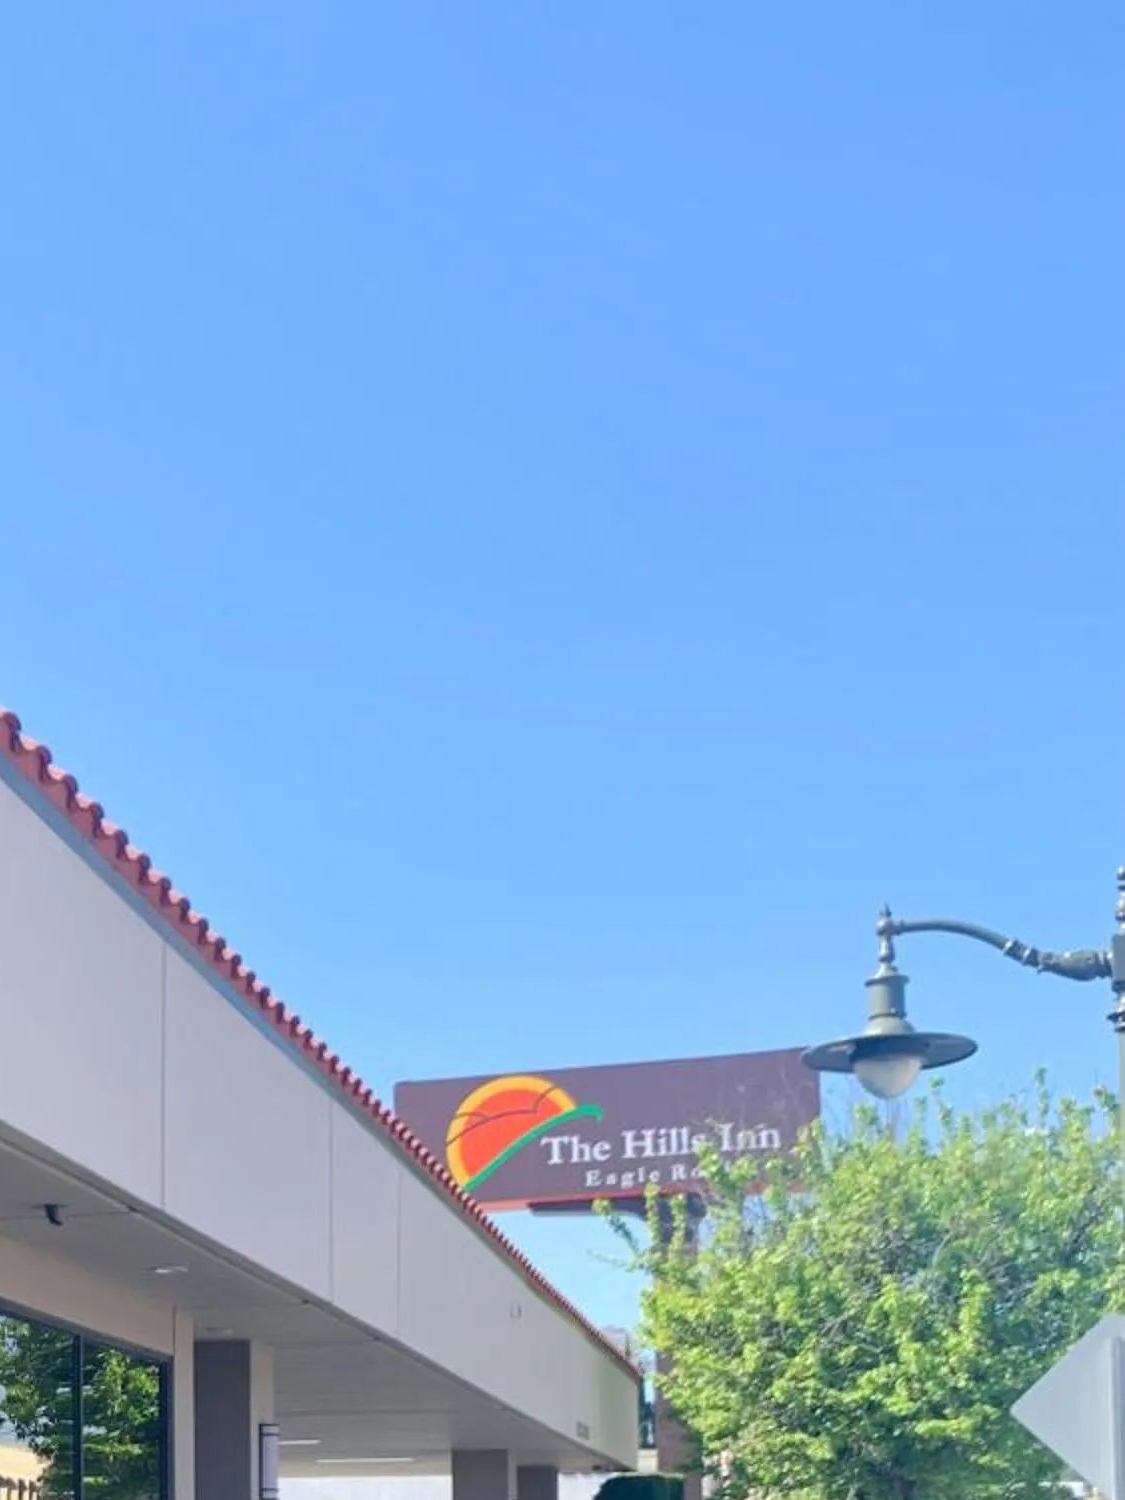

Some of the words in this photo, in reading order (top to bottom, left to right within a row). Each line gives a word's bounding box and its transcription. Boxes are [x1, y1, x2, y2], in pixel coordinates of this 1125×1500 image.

[539, 1134, 612, 1166] The
[621, 1126, 709, 1159] Hills
[718, 1122, 781, 1152] Inn
[584, 1165, 660, 1188] Eagle
